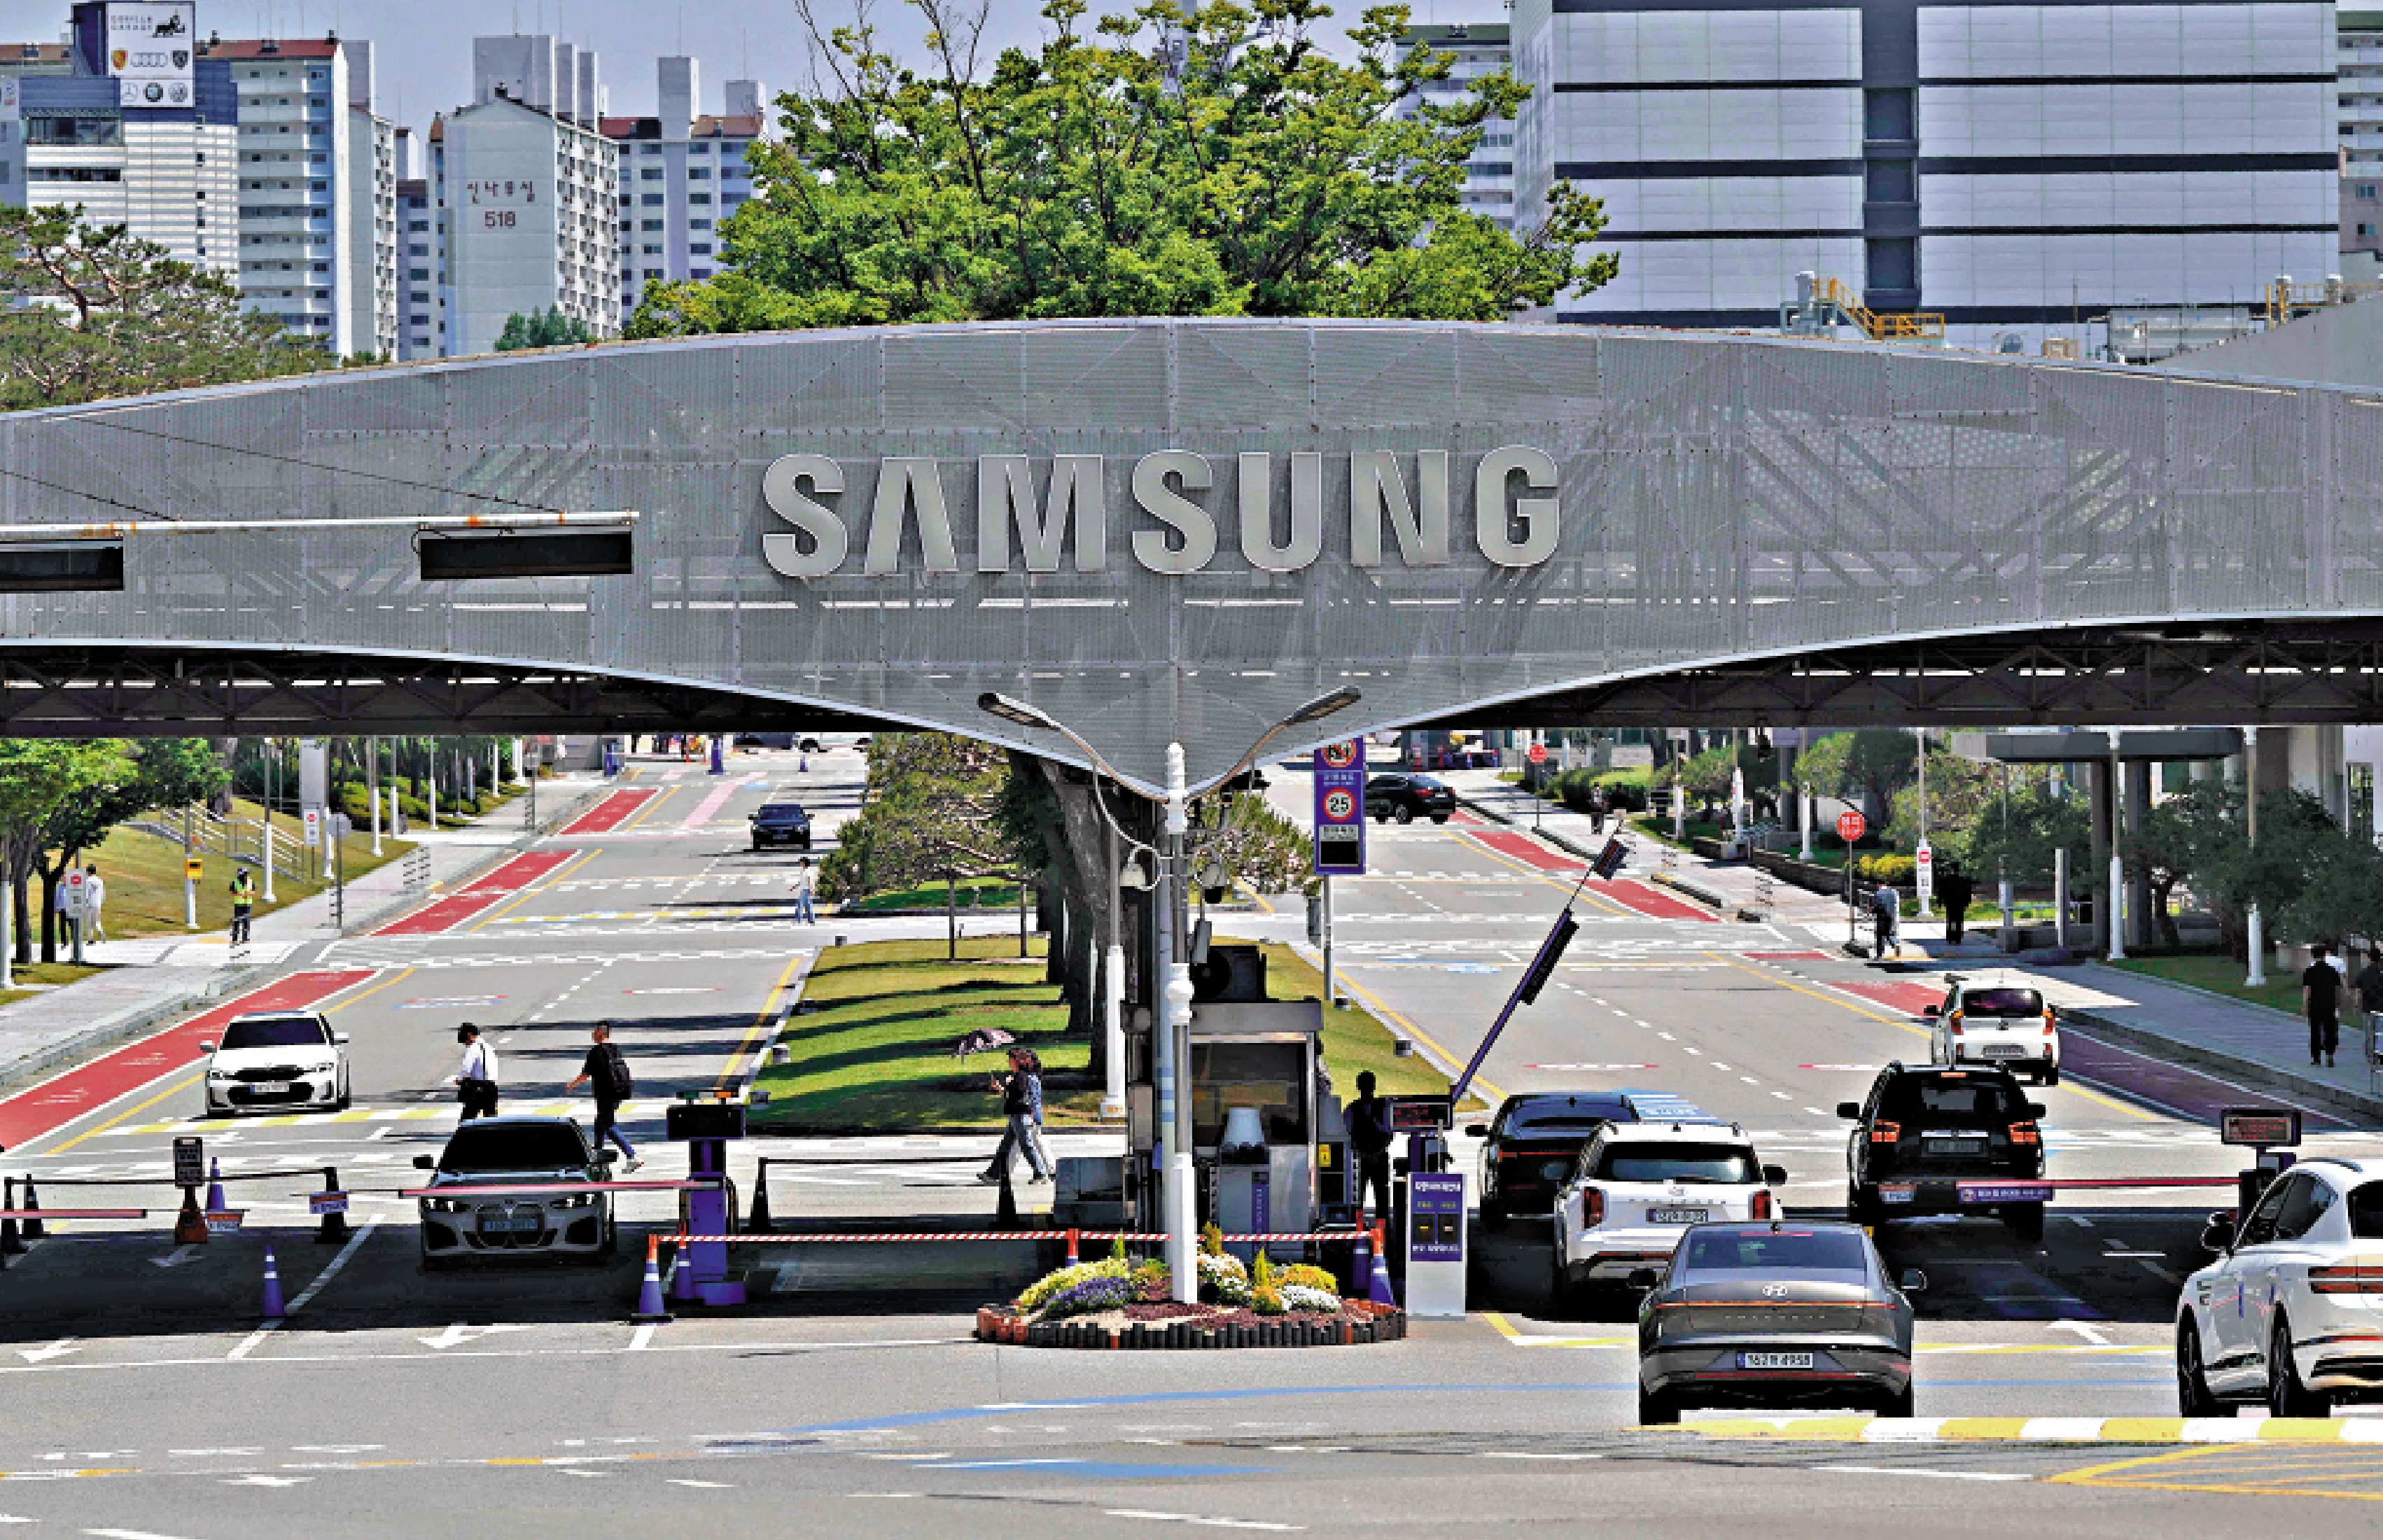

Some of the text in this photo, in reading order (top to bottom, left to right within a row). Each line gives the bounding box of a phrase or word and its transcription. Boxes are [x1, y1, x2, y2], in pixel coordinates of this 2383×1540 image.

[484, 211, 516, 227] 518
[762, 445, 1560, 578] SAMSUNG
[1329, 797, 1348, 812] 25
